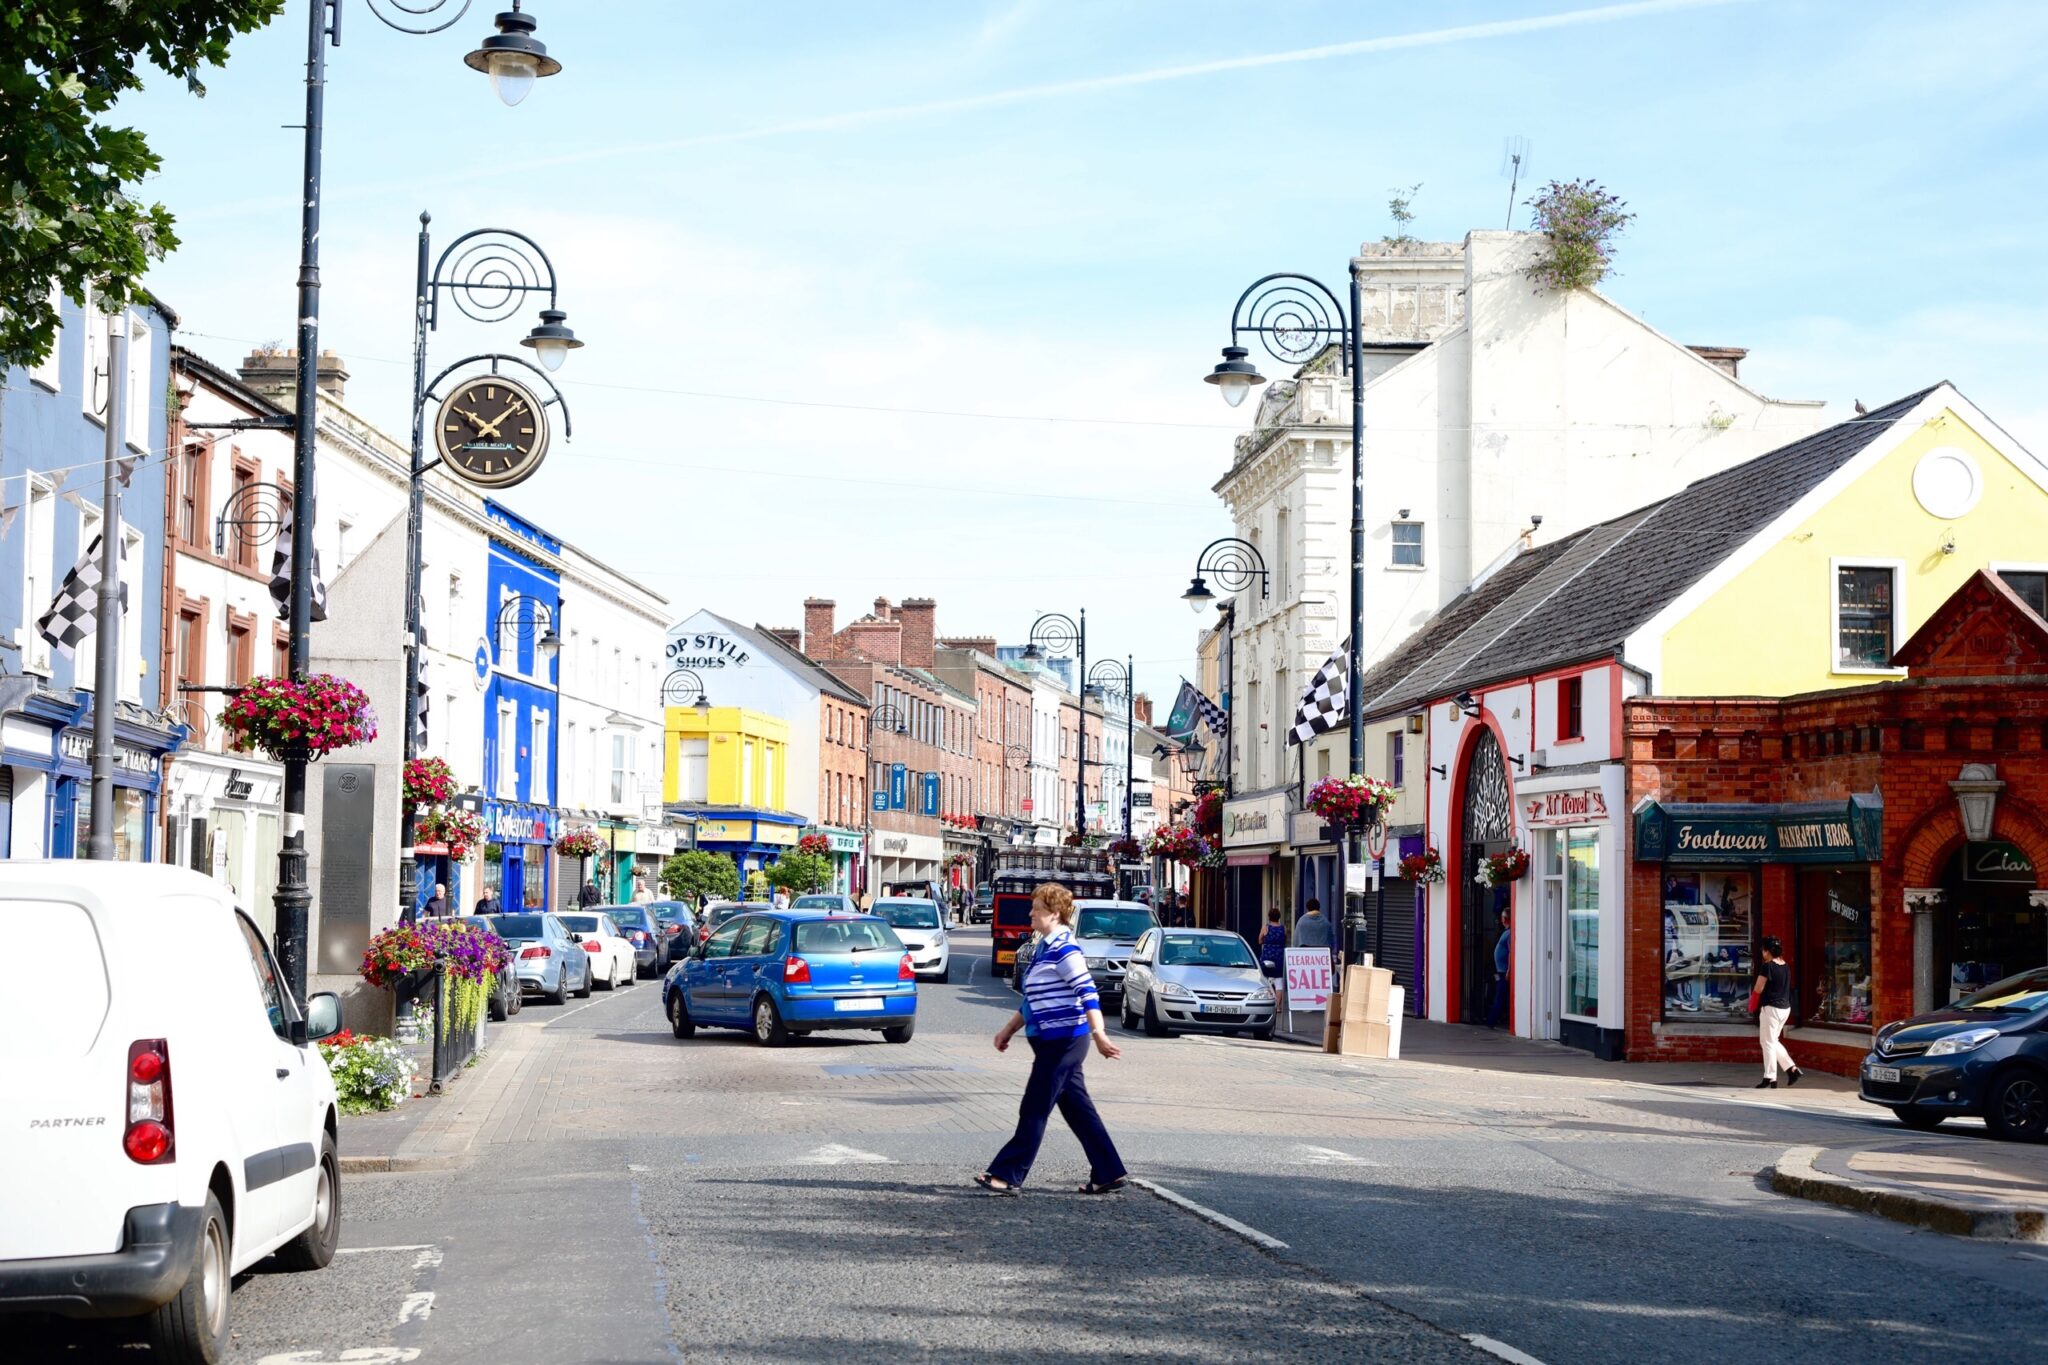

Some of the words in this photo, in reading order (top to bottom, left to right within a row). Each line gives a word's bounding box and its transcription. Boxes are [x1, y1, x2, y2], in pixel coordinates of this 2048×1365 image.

[676, 657, 725, 668] SHOES
[695, 635, 749, 667] STYLE
[1561, 790, 1588, 815] Travel
[1677, 825, 1768, 850] Footwear
[1777, 824, 1823, 848] HANRATTY
[1824, 822, 1854, 847] BROS.
[1287, 955, 1330, 966] CLEARANCE
[1288, 969, 1331, 990] SALE
[30, 1116, 106, 1129] PARTNER
